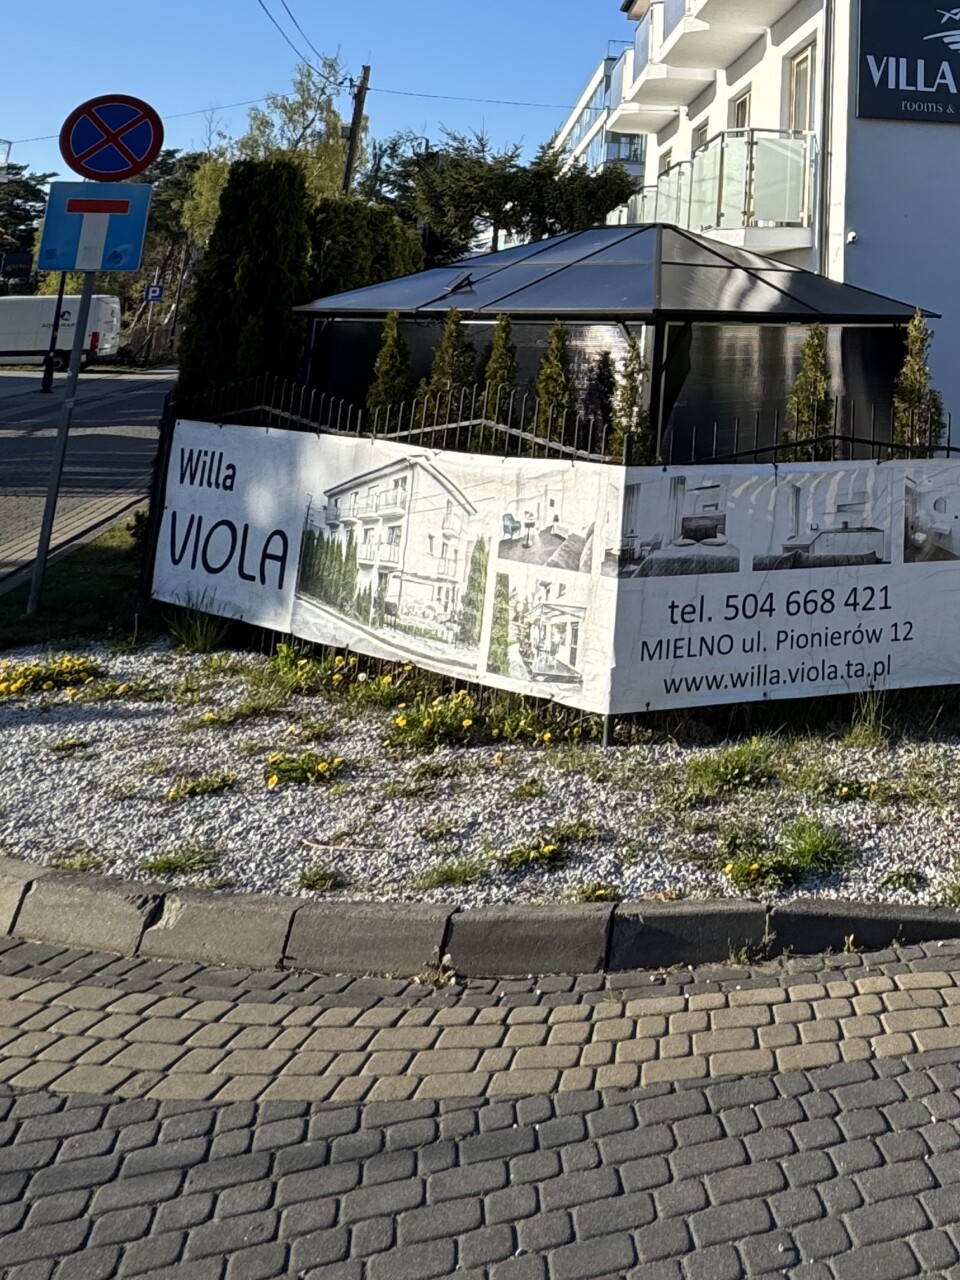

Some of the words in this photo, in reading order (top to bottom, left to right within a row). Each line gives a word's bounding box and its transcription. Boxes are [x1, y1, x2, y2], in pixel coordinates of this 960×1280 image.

[866, 54, 958, 94] VILLA
[901, 100, 943, 113] rooms
[946, 105, 955, 114] &
[149, 288, 160, 300] P
[179, 447, 237, 492] Willa
[170, 510, 289, 590] VIOLA
[668, 595, 713, 625] tel.
[723, 592, 776, 621] 504
[785, 588, 836, 617] 668
[843, 585, 892, 613] 421
[640, 634, 734, 662] MIELNO
[742, 631, 768, 653] ul.
[776, 624, 883, 651] Pionierów
[890, 621, 914, 643] 12
[663, 654, 892, 694] www.willa.viola.ta.pl
